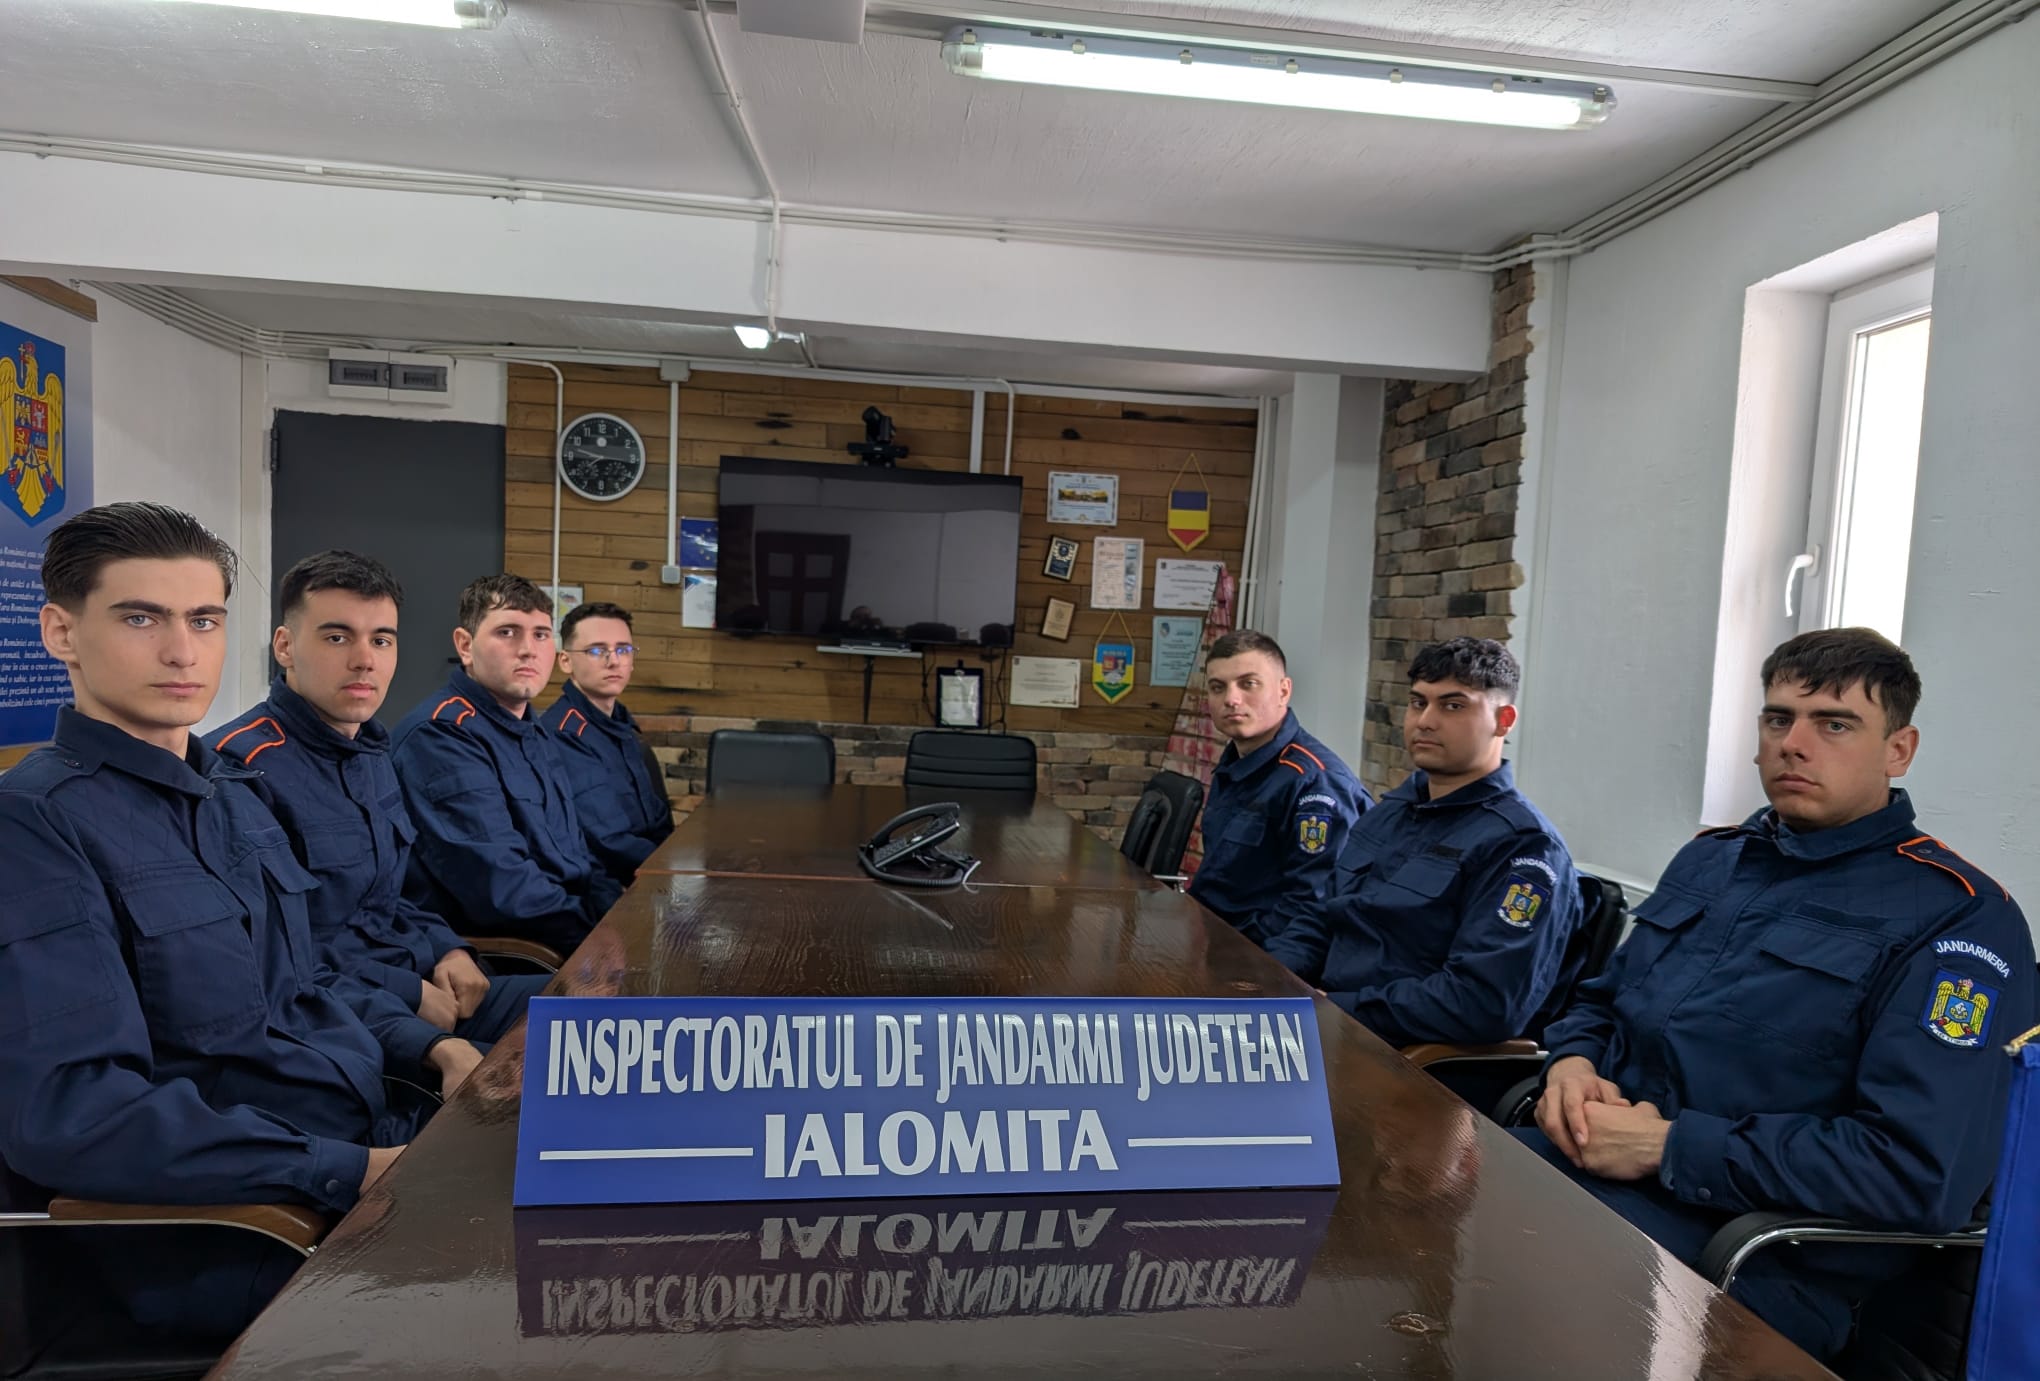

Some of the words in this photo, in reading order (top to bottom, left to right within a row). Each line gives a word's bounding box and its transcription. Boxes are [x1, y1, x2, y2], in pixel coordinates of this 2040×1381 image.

[585, 427, 591, 437] 11
[598, 423, 607, 434] 12
[574, 436, 582, 446] 10
[625, 439, 631, 449] 2
[1936, 940, 2010, 978] JANDARMERIA
[546, 1015, 862, 1096] INSPECTORATUL
[876, 1015, 924, 1087] DE
[936, 1014, 1124, 1104] JANDARMI
[1134, 1014, 1309, 1102] JUDETEAN
[765, 1110, 1119, 1178] IALOMITA
